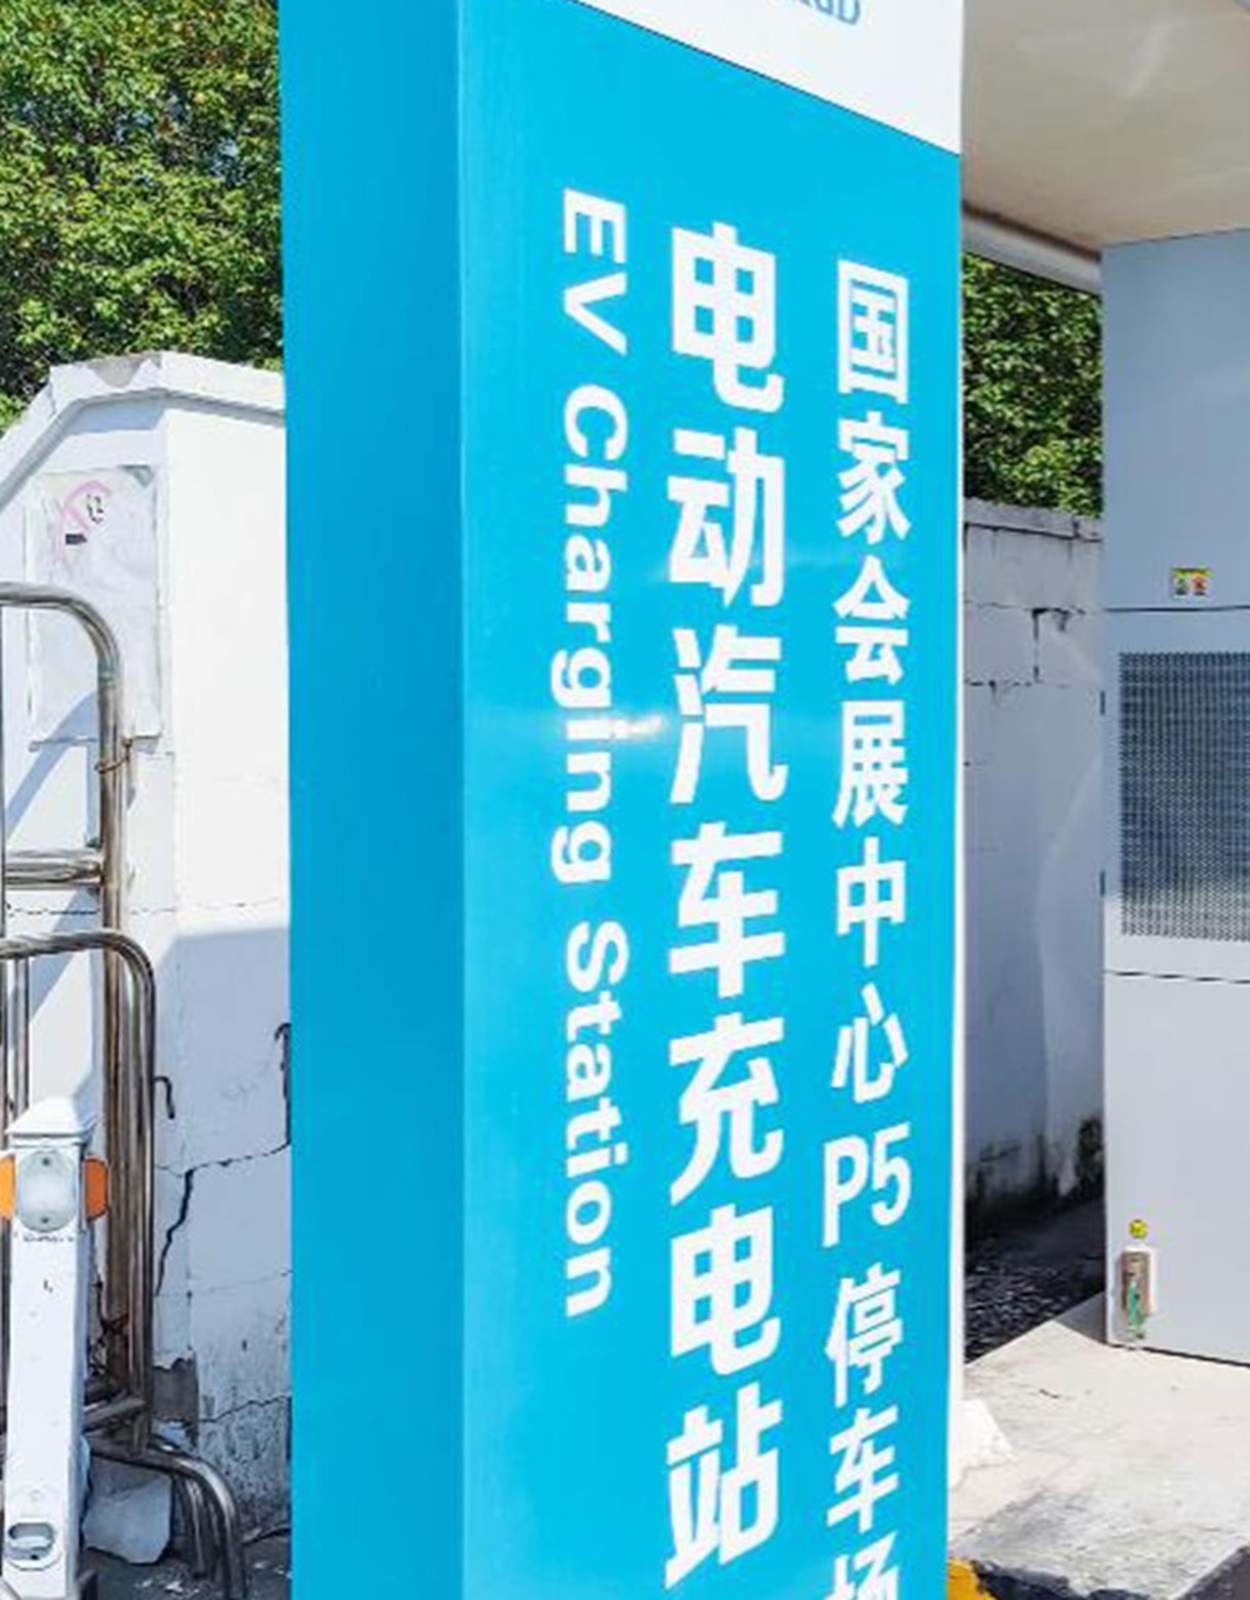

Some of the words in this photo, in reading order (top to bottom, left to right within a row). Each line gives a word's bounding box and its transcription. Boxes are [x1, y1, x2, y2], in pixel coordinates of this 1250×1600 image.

[563, 187, 628, 355] EV
[551, 383, 628, 885] Charging
[566, 920, 630, 1317] Station
[665, 221, 788, 1588] 电动汽车充电站
